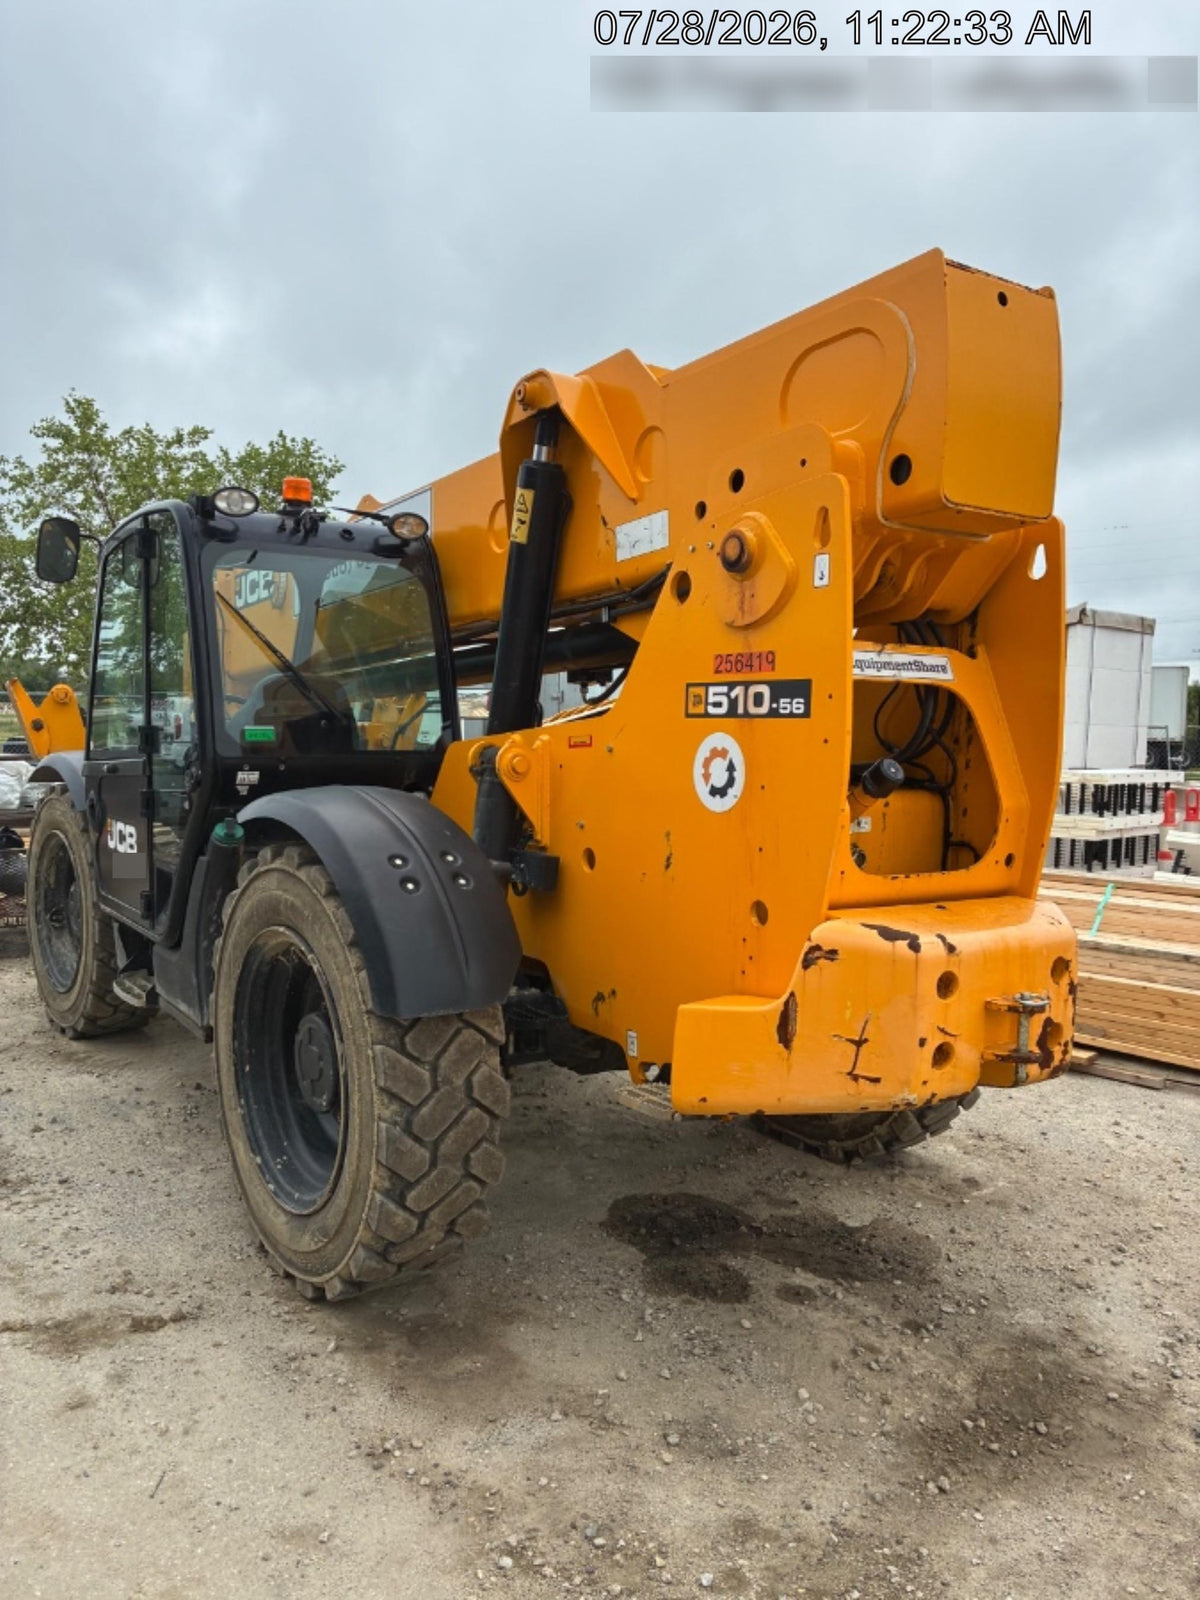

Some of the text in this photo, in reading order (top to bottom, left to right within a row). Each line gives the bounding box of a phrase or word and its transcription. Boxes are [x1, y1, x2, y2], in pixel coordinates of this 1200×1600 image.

[714, 651, 775, 674] 256419
[853, 658, 948, 674] quipmentShare
[707, 684, 805, 715] 510-56
[107, 819, 138, 854] JCB
